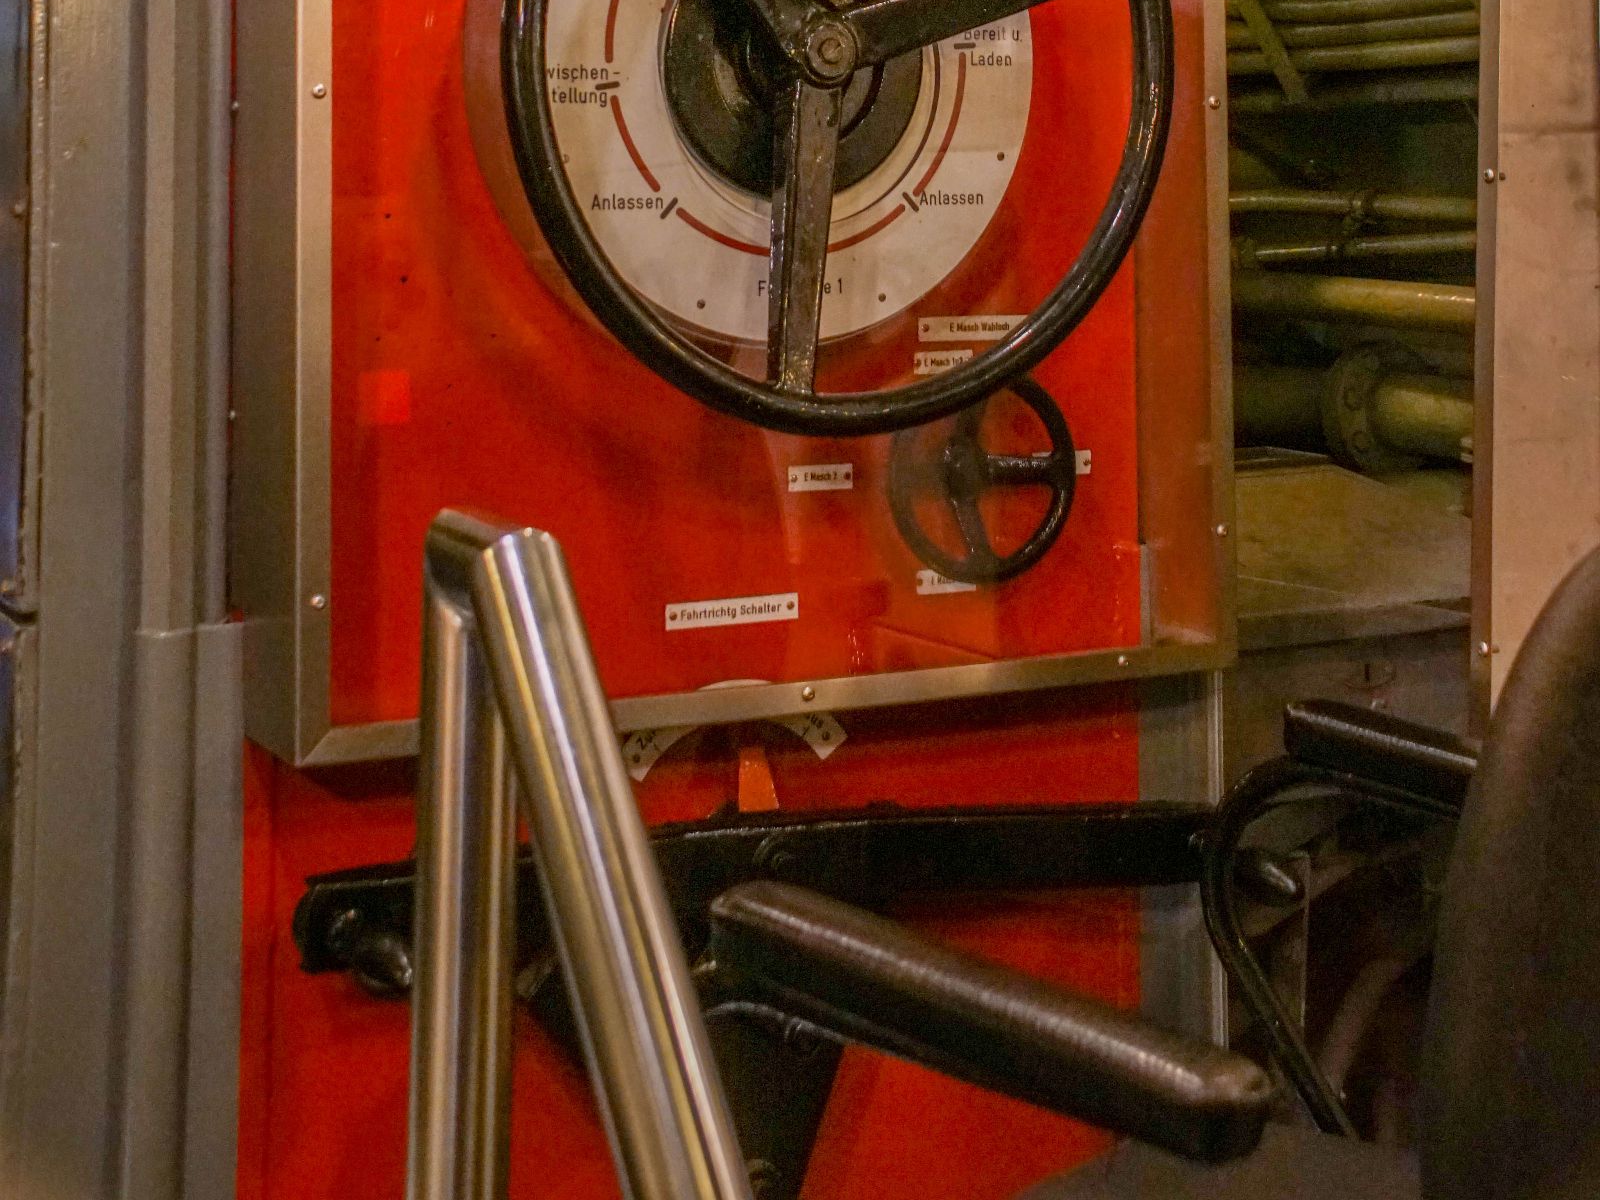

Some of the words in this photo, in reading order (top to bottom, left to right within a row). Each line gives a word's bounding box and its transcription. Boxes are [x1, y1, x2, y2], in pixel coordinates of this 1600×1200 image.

[970, 50, 1013, 67] Laden
[552, 89, 608, 108] tellung
[591, 194, 664, 211] Anlassen
[919, 190, 984, 206] Anlassen
[837, 277, 843, 294] 1
[949, 322, 955, 333] E
[956, 322, 979, 333] Masch
[810, 471, 832, 481] Masch
[680, 605, 737, 621] Fahrtrichtg
[740, 601, 782, 615] Schalter
